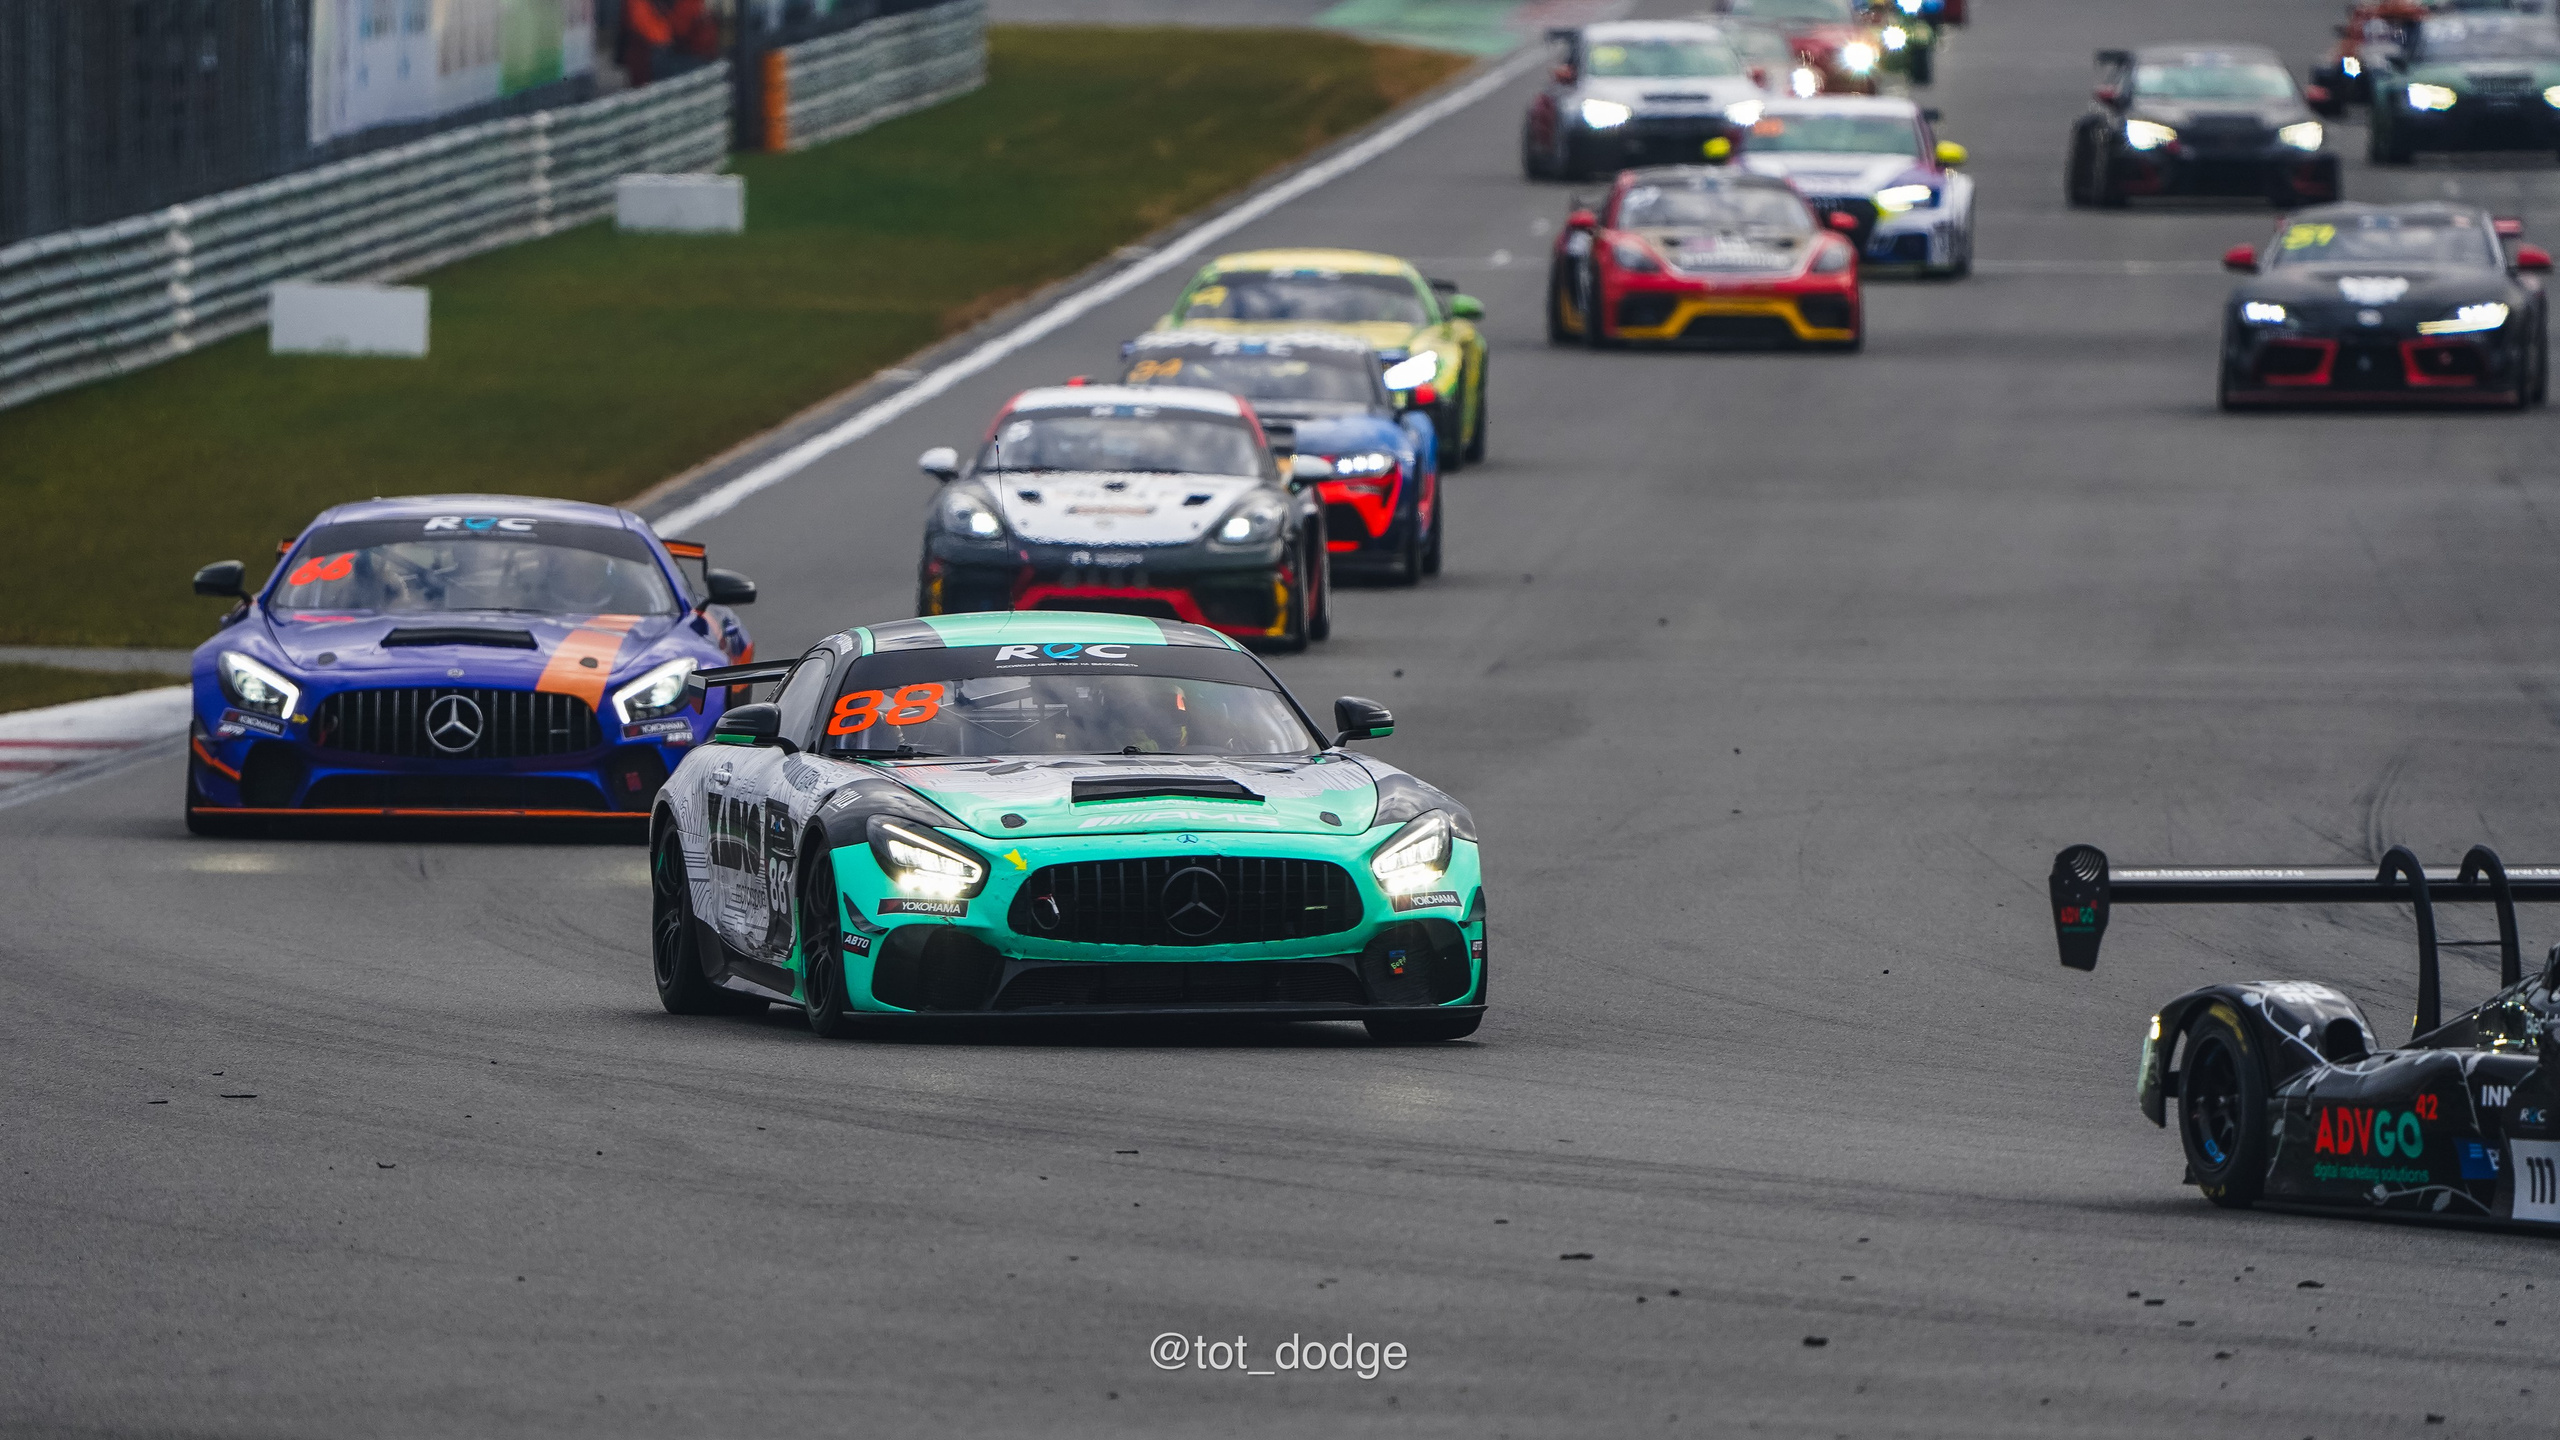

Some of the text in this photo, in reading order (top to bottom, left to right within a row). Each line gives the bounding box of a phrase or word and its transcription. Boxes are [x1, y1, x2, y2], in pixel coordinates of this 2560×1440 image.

[289, 552, 356, 586] 66
[827, 682, 945, 736] 88
[641, 720, 687, 734] YOKOHAMA
[1143, 811, 1280, 827] AMG
[769, 856, 789, 915] 88
[902, 901, 961, 914] YOKOHAMA
[1411, 894, 1458, 906] YOKOHAMA
[844, 934, 870, 949] АВТО
[2314, 1094, 2438, 1158] ADVGO 42
[2313, 1162, 2429, 1184] digital marketing solutions
